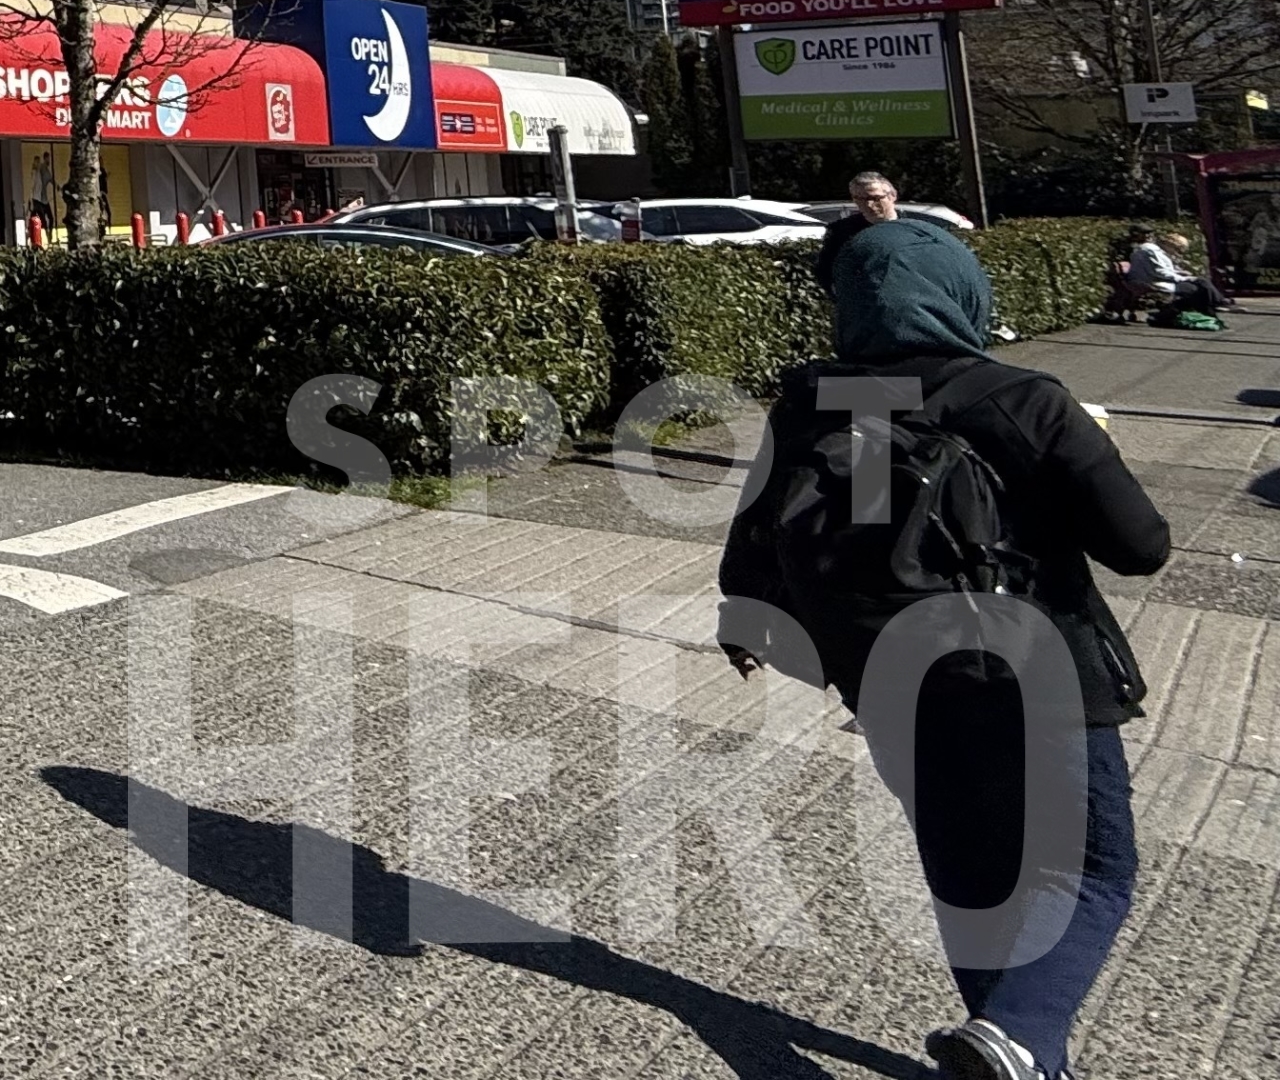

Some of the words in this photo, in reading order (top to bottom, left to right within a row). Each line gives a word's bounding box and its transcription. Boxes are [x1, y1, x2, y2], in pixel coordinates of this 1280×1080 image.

[740, 0, 795, 16] FOOD
[351, 37, 388, 63] OPEN
[802, 38, 859, 60] CARE
[864, 33, 934, 58] POINT
[368, 64, 389, 94] 24
[761, 99, 827, 114] Medical
[833, 100, 848, 112] &
[853, 98, 931, 113] Wellness
[107, 110, 151, 129] MART
[815, 113, 875, 126] Clinics
[320, 155, 375, 164] ENTRANCE
